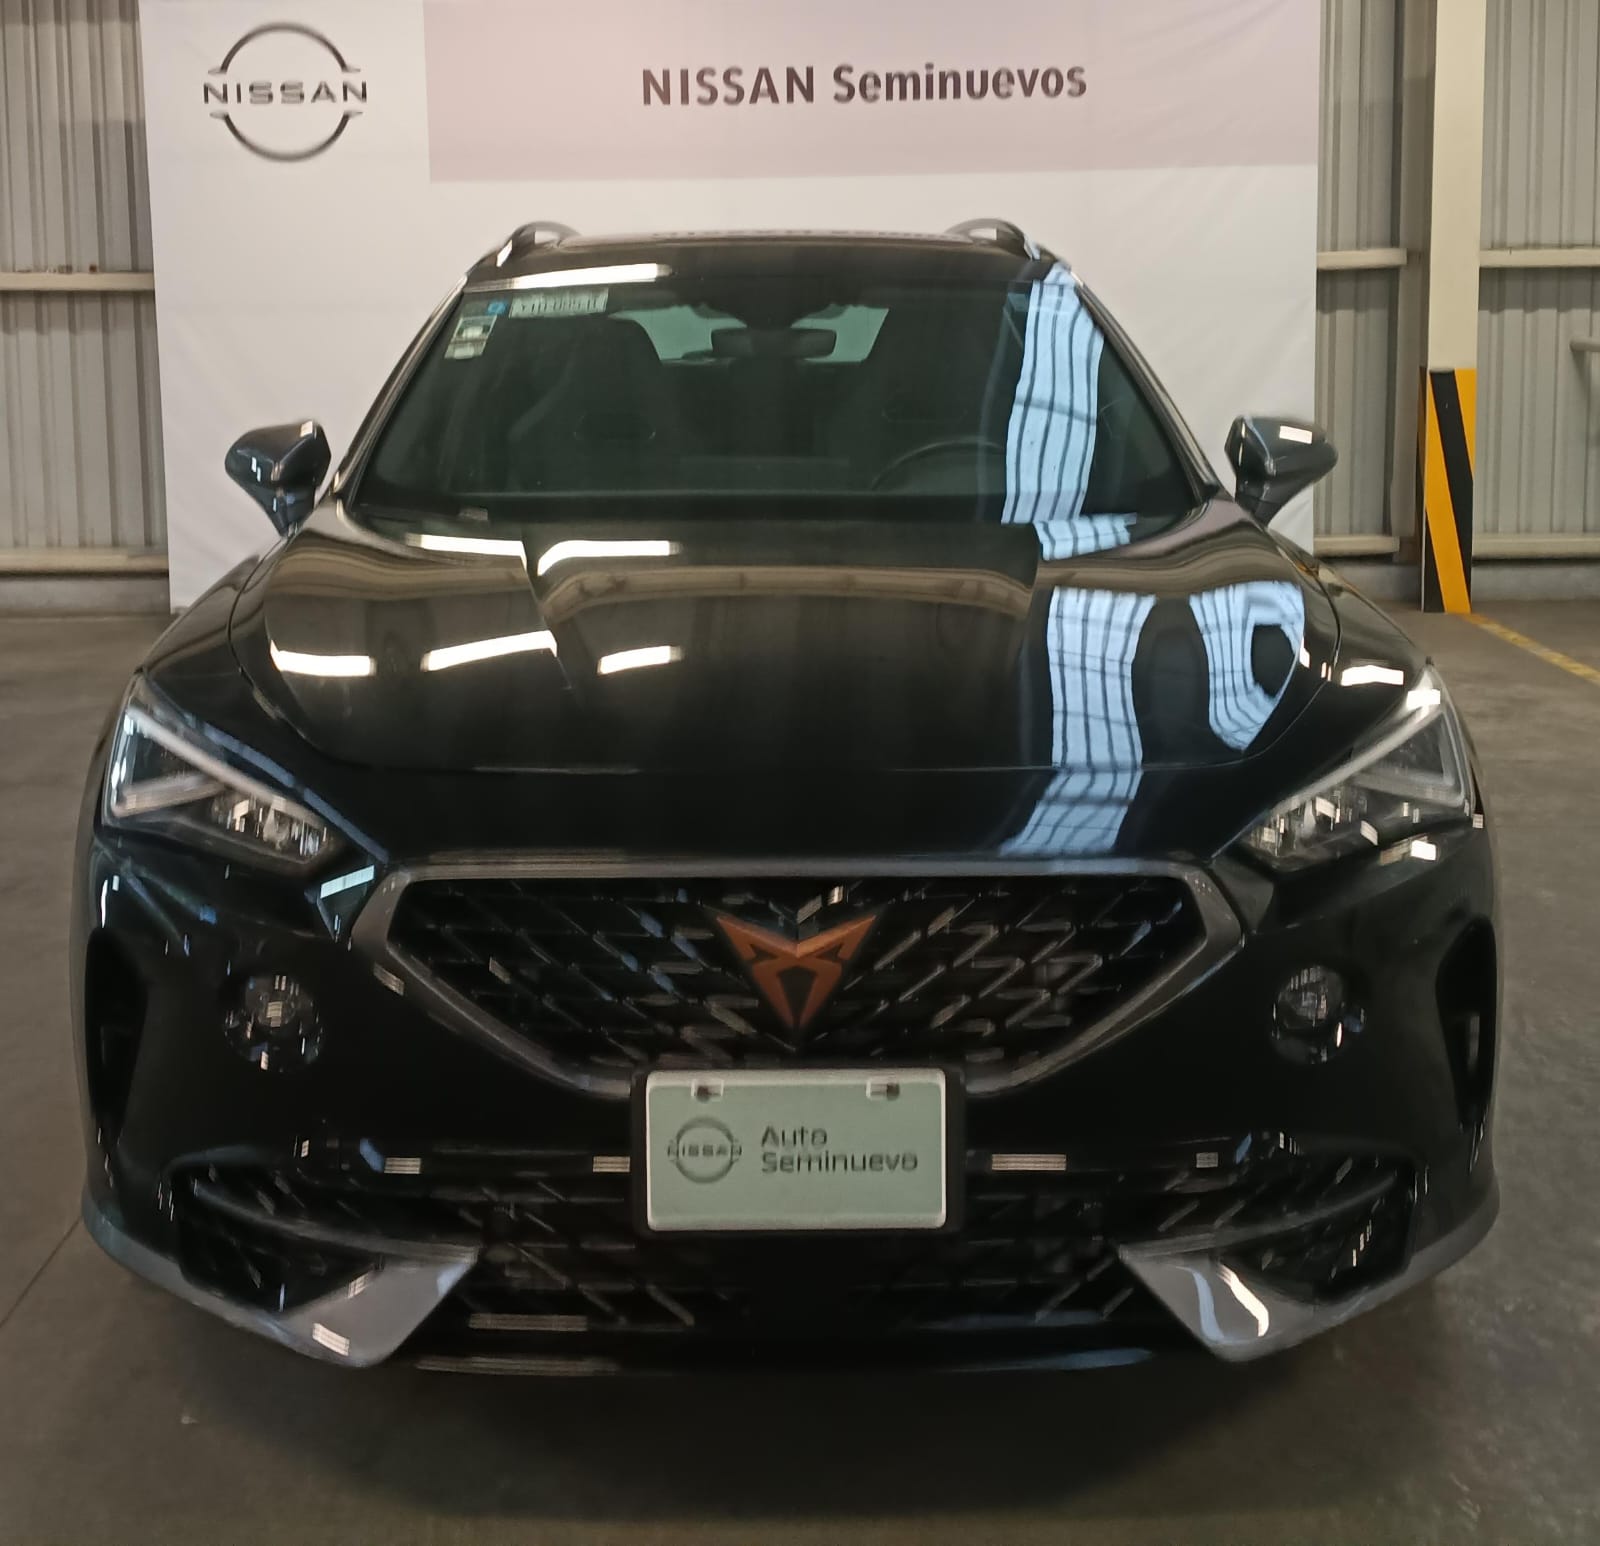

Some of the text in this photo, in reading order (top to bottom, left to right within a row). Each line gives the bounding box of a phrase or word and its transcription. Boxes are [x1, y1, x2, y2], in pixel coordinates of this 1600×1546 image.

[203, 80, 368, 105] NISSAN
[642, 62, 1088, 106] NISSAN Seminuevos
[760, 1125, 828, 1148] Auto
[667, 1143, 743, 1158] NISSAN
[760, 1150, 919, 1174] Seminuevo
